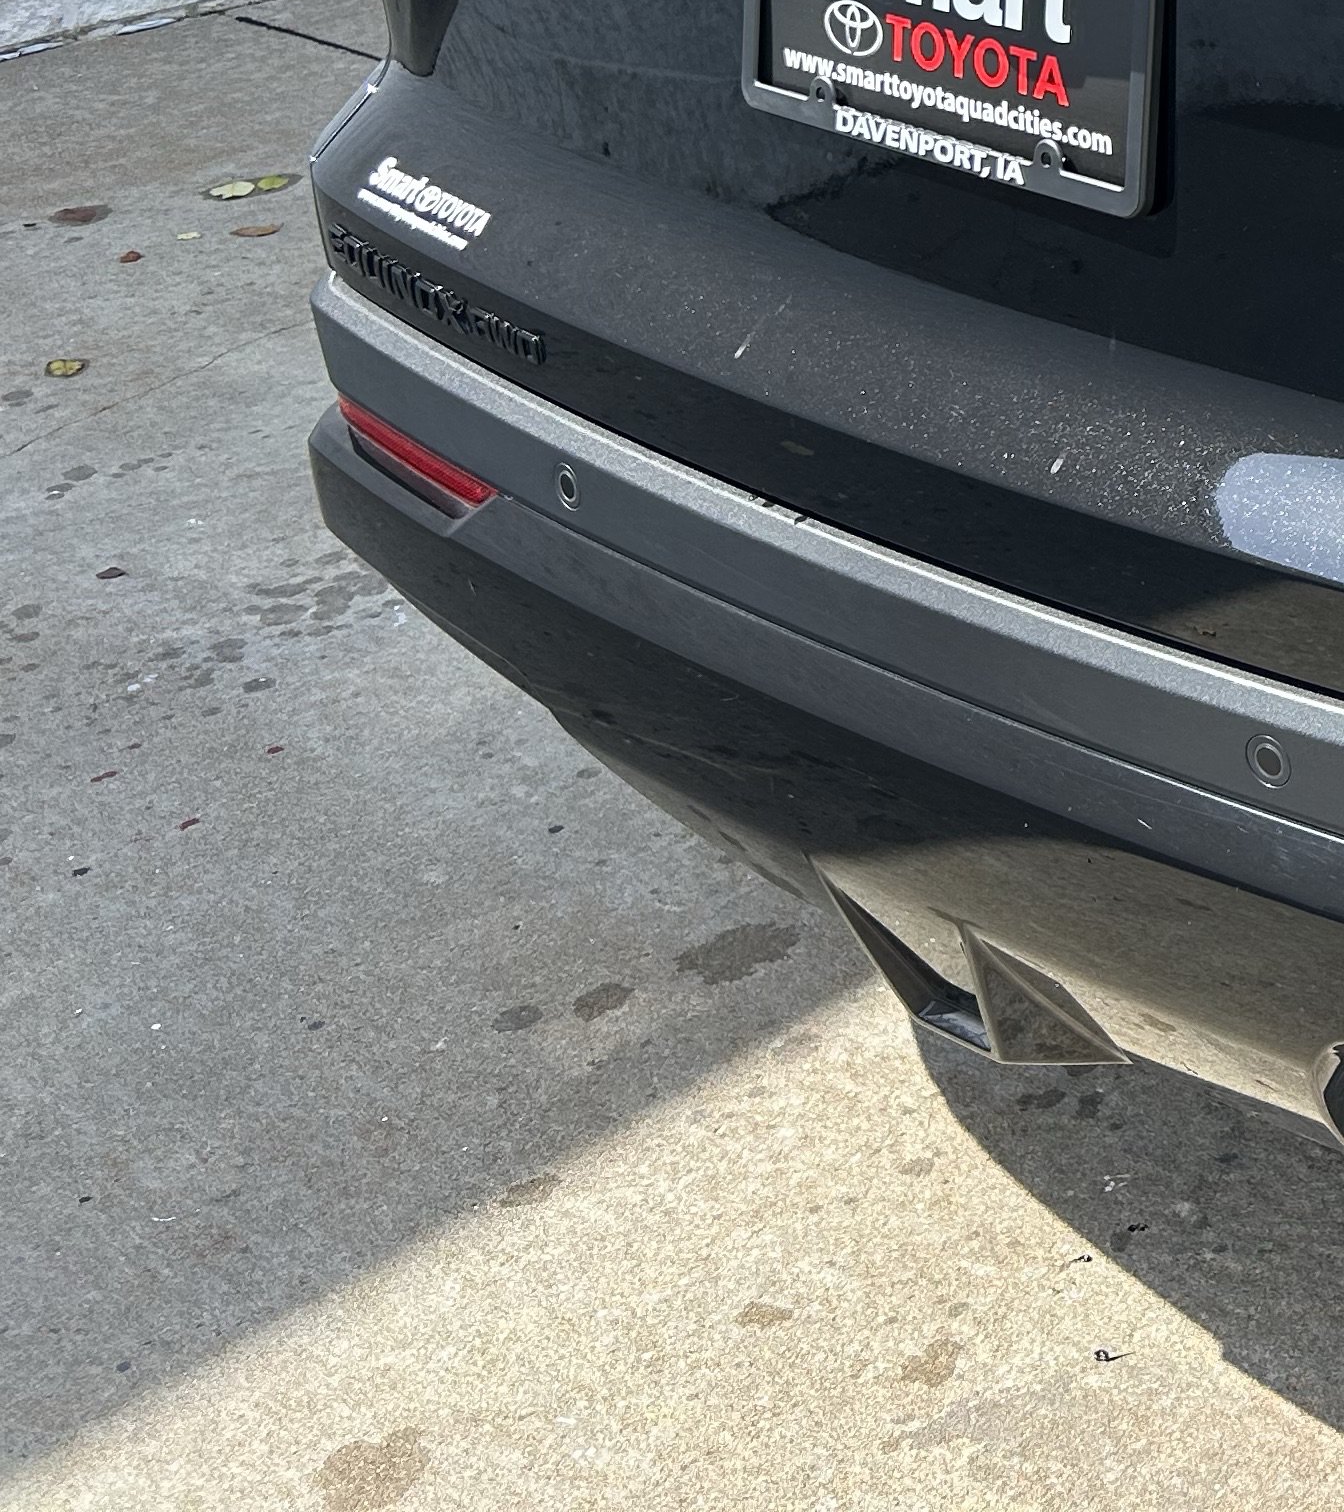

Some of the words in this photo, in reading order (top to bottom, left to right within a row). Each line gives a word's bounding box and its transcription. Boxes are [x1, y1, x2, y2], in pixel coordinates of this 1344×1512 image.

[783, 47, 1114, 156] www.smarttoyotaquadcities.com
[885, 13, 1070, 107] TOYOTA
[834, 106, 991, 179] DAVENPORT,
[996, 154, 1026, 186] IA
[369, 156, 430, 204] Smart
[431, 191, 492, 237] TOYOTA
[329, 223, 469, 336] EQUINOX
